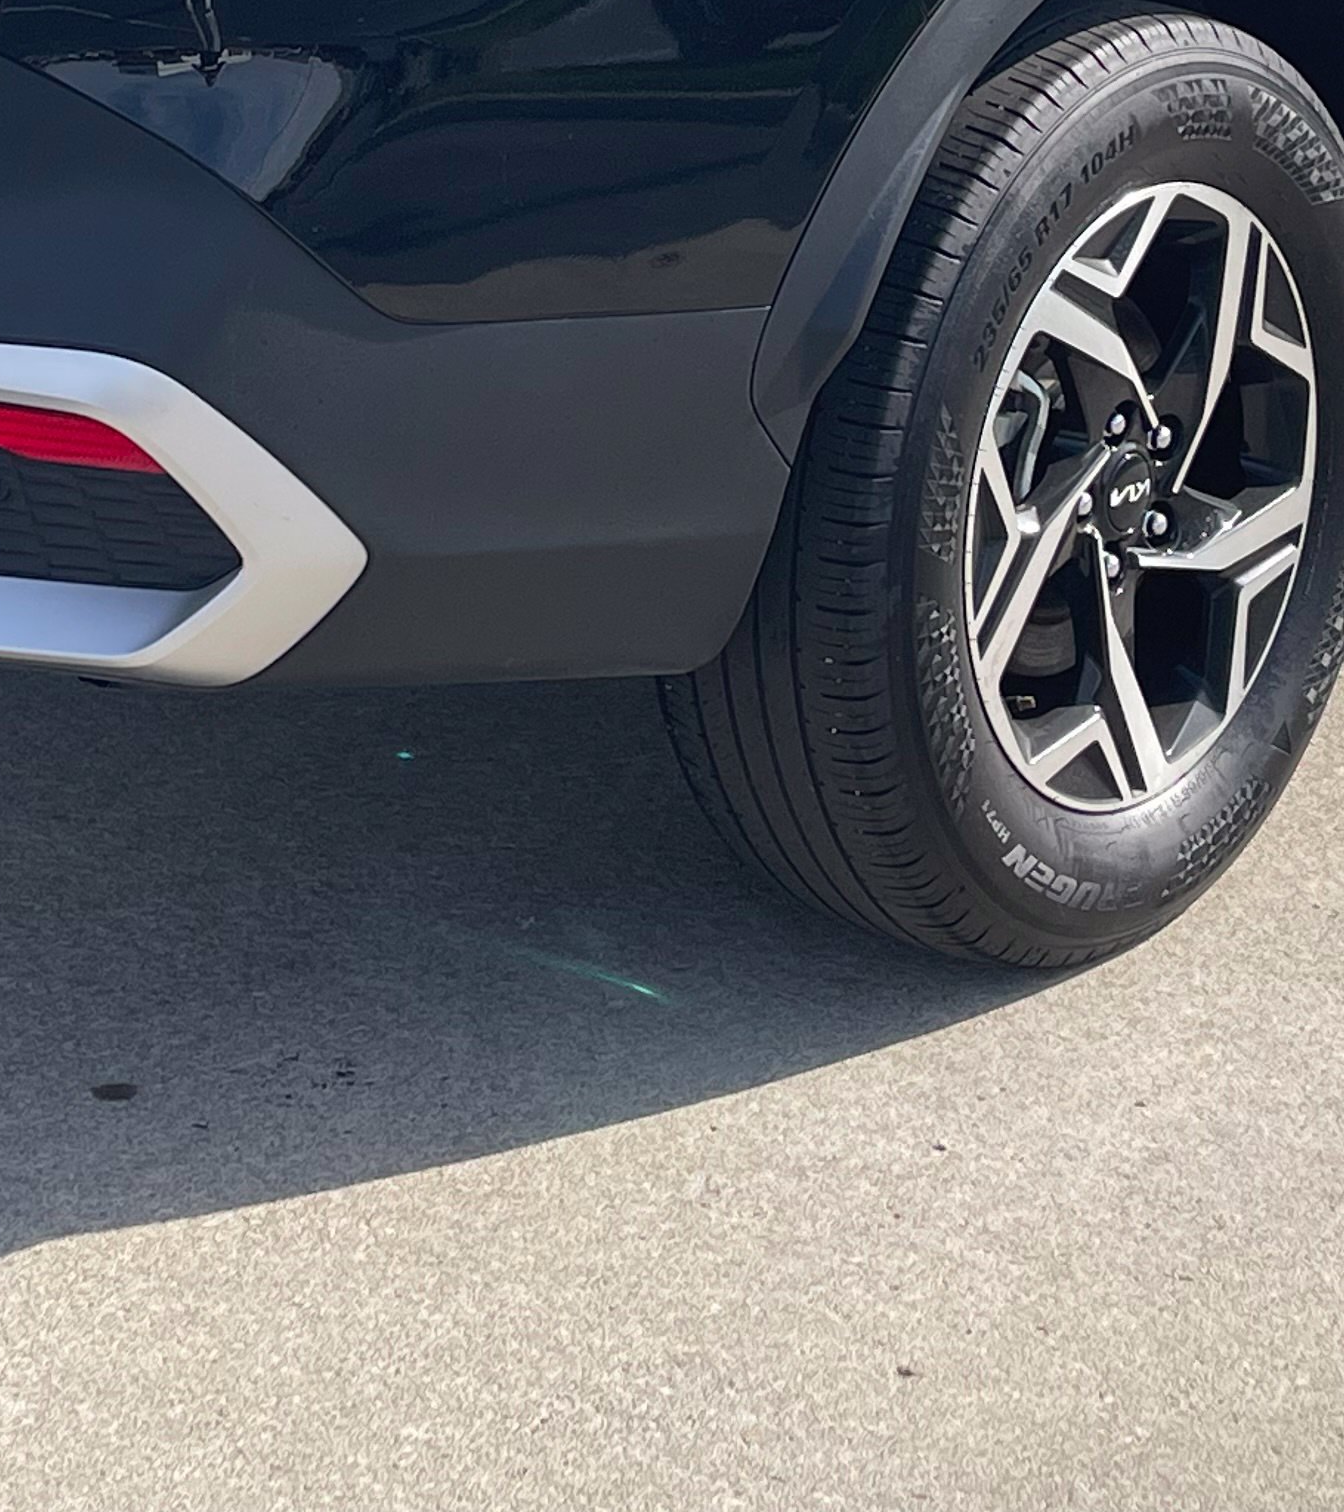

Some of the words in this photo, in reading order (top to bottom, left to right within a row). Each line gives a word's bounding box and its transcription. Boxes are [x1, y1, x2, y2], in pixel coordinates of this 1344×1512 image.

[1034, 182, 1073, 245] R17
[1079, 122, 1136, 185] 104H
[981, 799, 1012, 843] HP71
